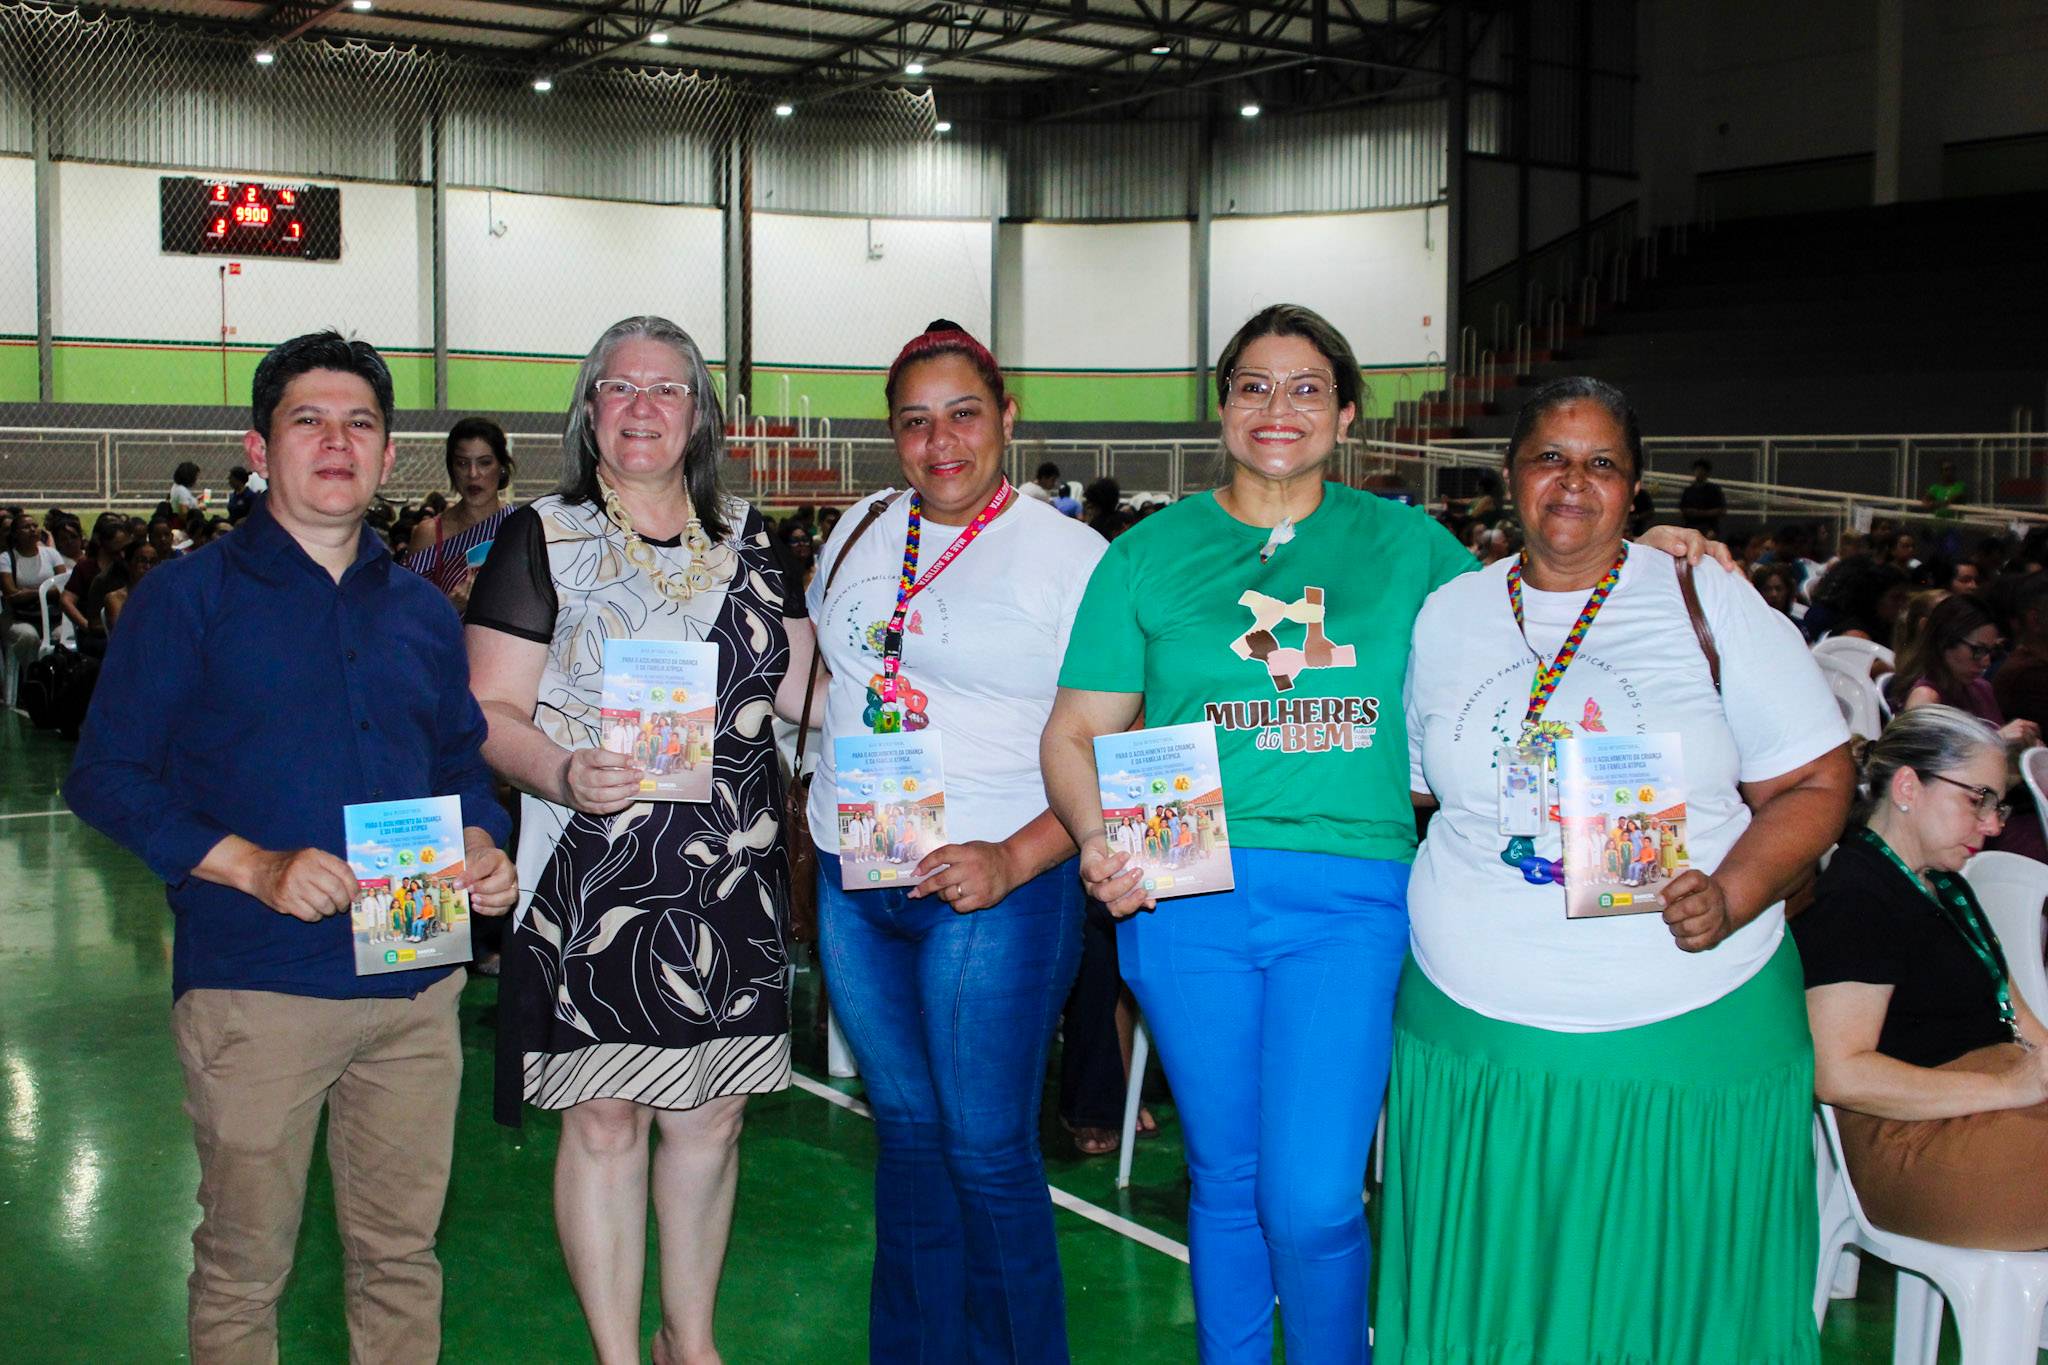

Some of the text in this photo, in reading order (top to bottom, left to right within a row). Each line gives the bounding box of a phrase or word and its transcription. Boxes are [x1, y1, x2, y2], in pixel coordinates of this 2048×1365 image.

[216, 185, 225, 200] 2
[247, 187, 256, 202] 2
[235, 206, 269, 223] 9900
[216, 219, 226, 234] 2
[291, 223, 300, 238] 7
[941, 552, 954, 563] DE
[917, 559, 945, 586] AUTISTA
[1454, 678, 1494, 742] MOVIMENTO
[1575, 653, 1613, 672] PICAS
[1205, 698, 1379, 730] MULHERES
[1257, 726, 1280, 749] do
[1281, 722, 1354, 752] BEM
